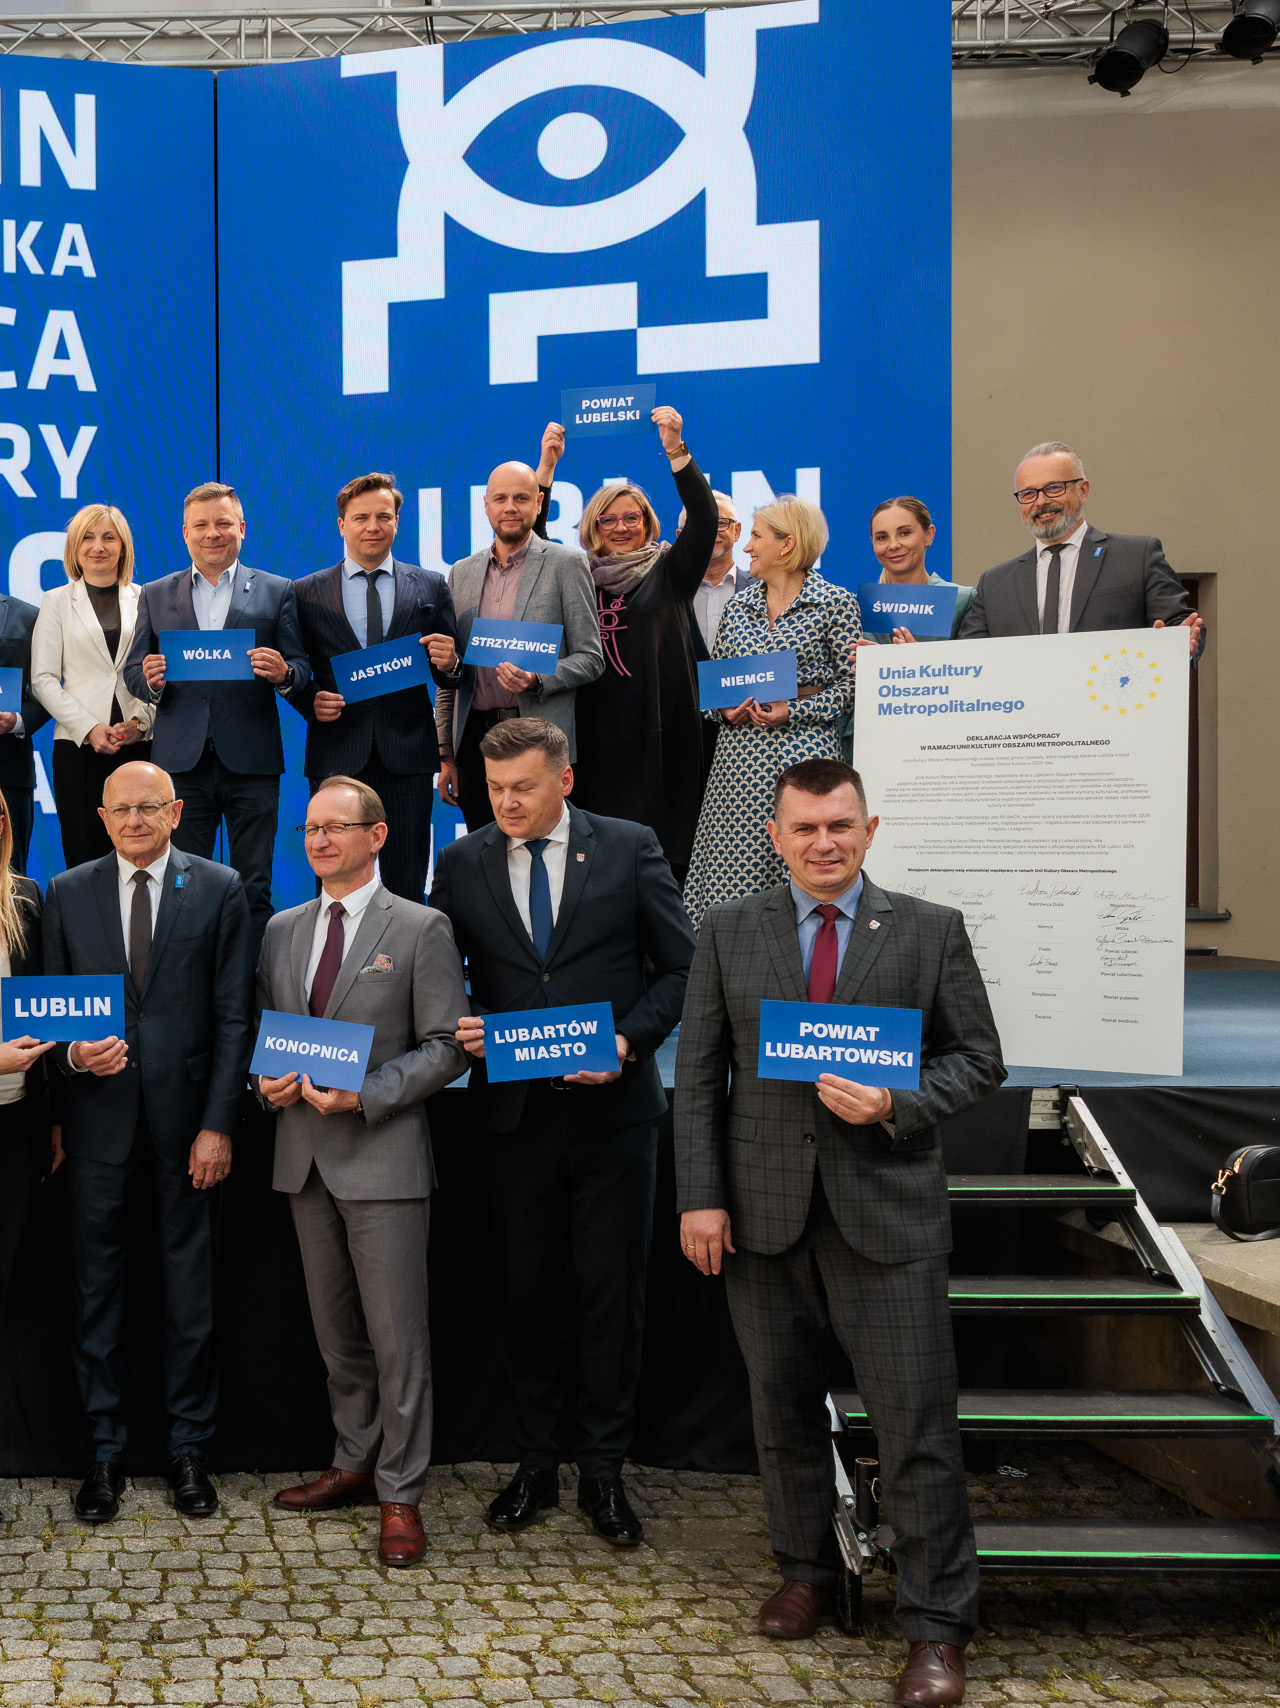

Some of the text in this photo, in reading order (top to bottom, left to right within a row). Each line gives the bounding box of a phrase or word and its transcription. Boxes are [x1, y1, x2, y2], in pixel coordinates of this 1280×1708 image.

[582, 397, 634, 409] POWIAT
[576, 410, 639, 424] LUBELSKI
[872, 600, 935, 616] ŚWIDNIK
[183, 648, 231, 659] WÓLKA
[471, 637, 557, 654] STRZYŻEWICE
[351, 656, 411, 681] JASTKÓW
[879, 663, 983, 681] Unia Kultury
[721, 671, 775, 687] NIEMCE
[878, 682, 950, 698] Obszaru
[877, 697, 1025, 717] Metropolitalnego
[1036, 739, 1111, 748] METROPOLITALNEGO
[15, 997, 111, 1017] LUBLIN
[494, 1020, 598, 1044] LUBARTÓW
[800, 1022, 879, 1041] POWIAT
[265, 1036, 359, 1063] KONOPNICA
[515, 1042, 587, 1062] MIASTO
[766, 1042, 913, 1067] LUBARTOWSKI
